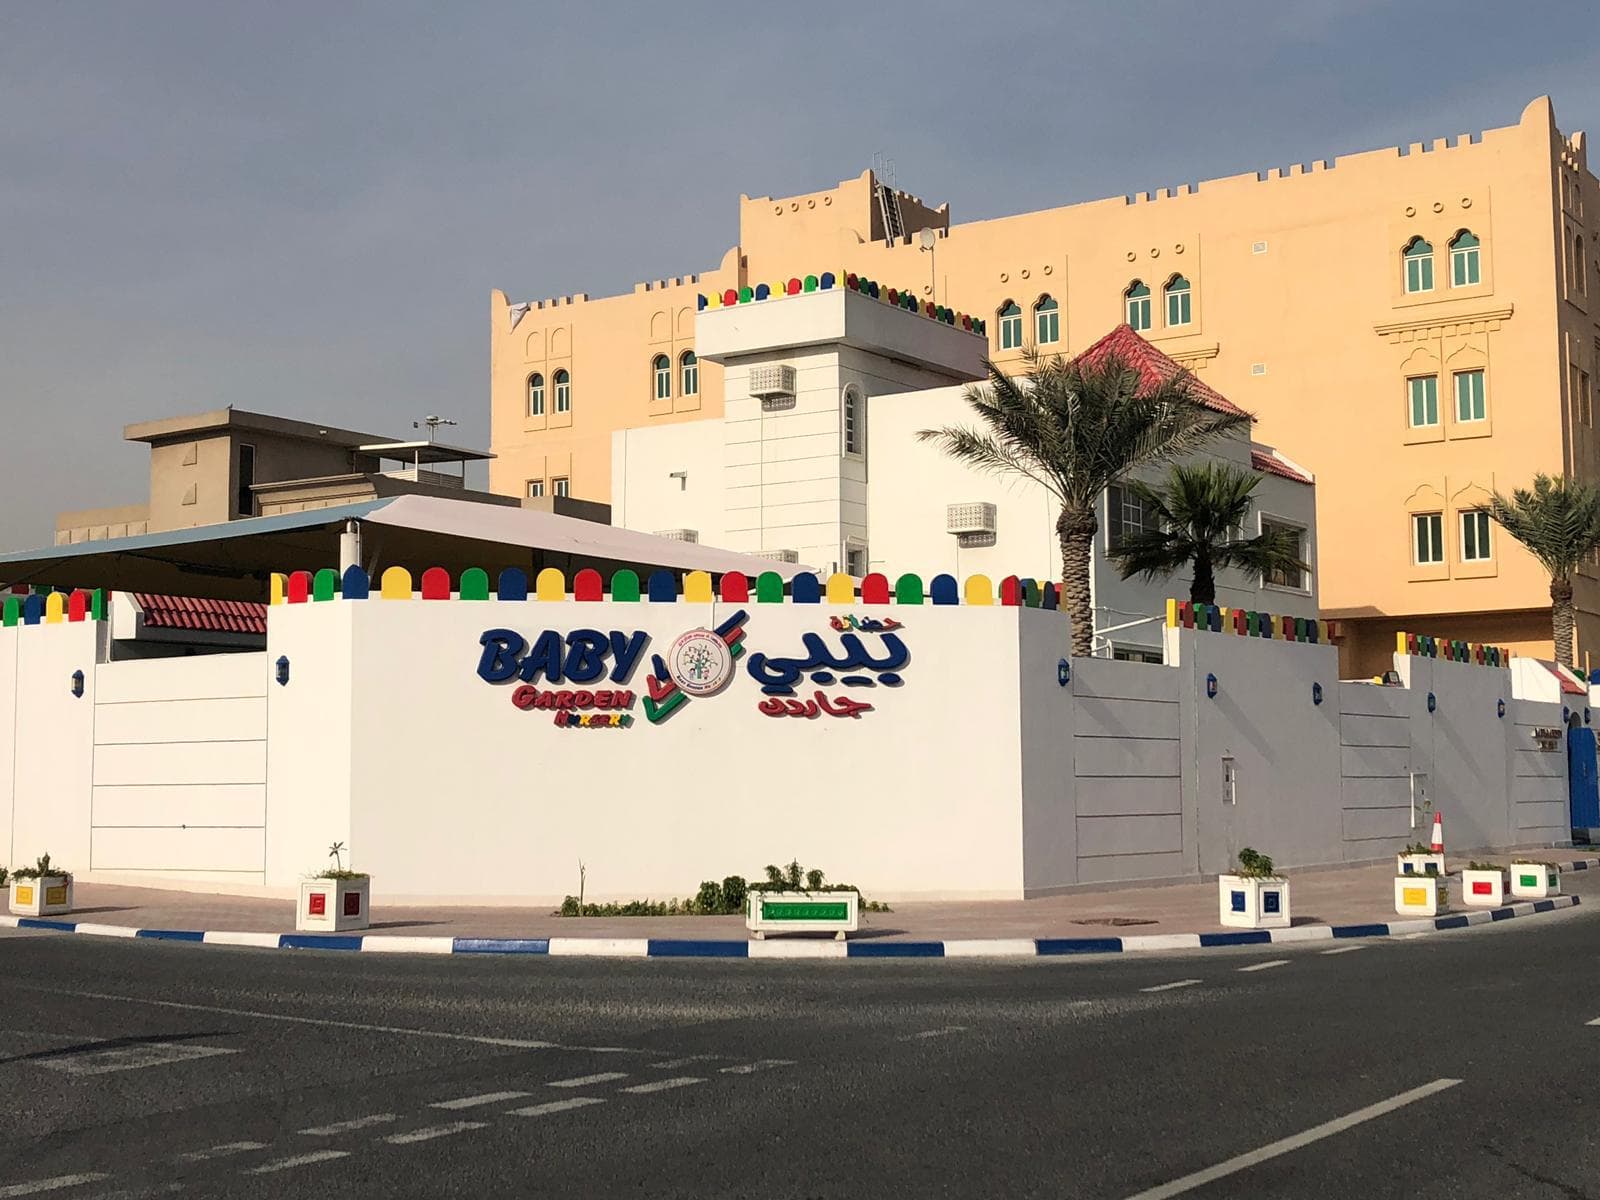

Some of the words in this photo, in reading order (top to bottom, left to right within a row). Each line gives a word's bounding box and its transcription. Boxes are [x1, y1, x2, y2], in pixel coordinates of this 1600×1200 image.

[477, 628, 648, 683] BABY
[747, 632, 908, 694] بيبي
[512, 685, 634, 710] GARDEN
